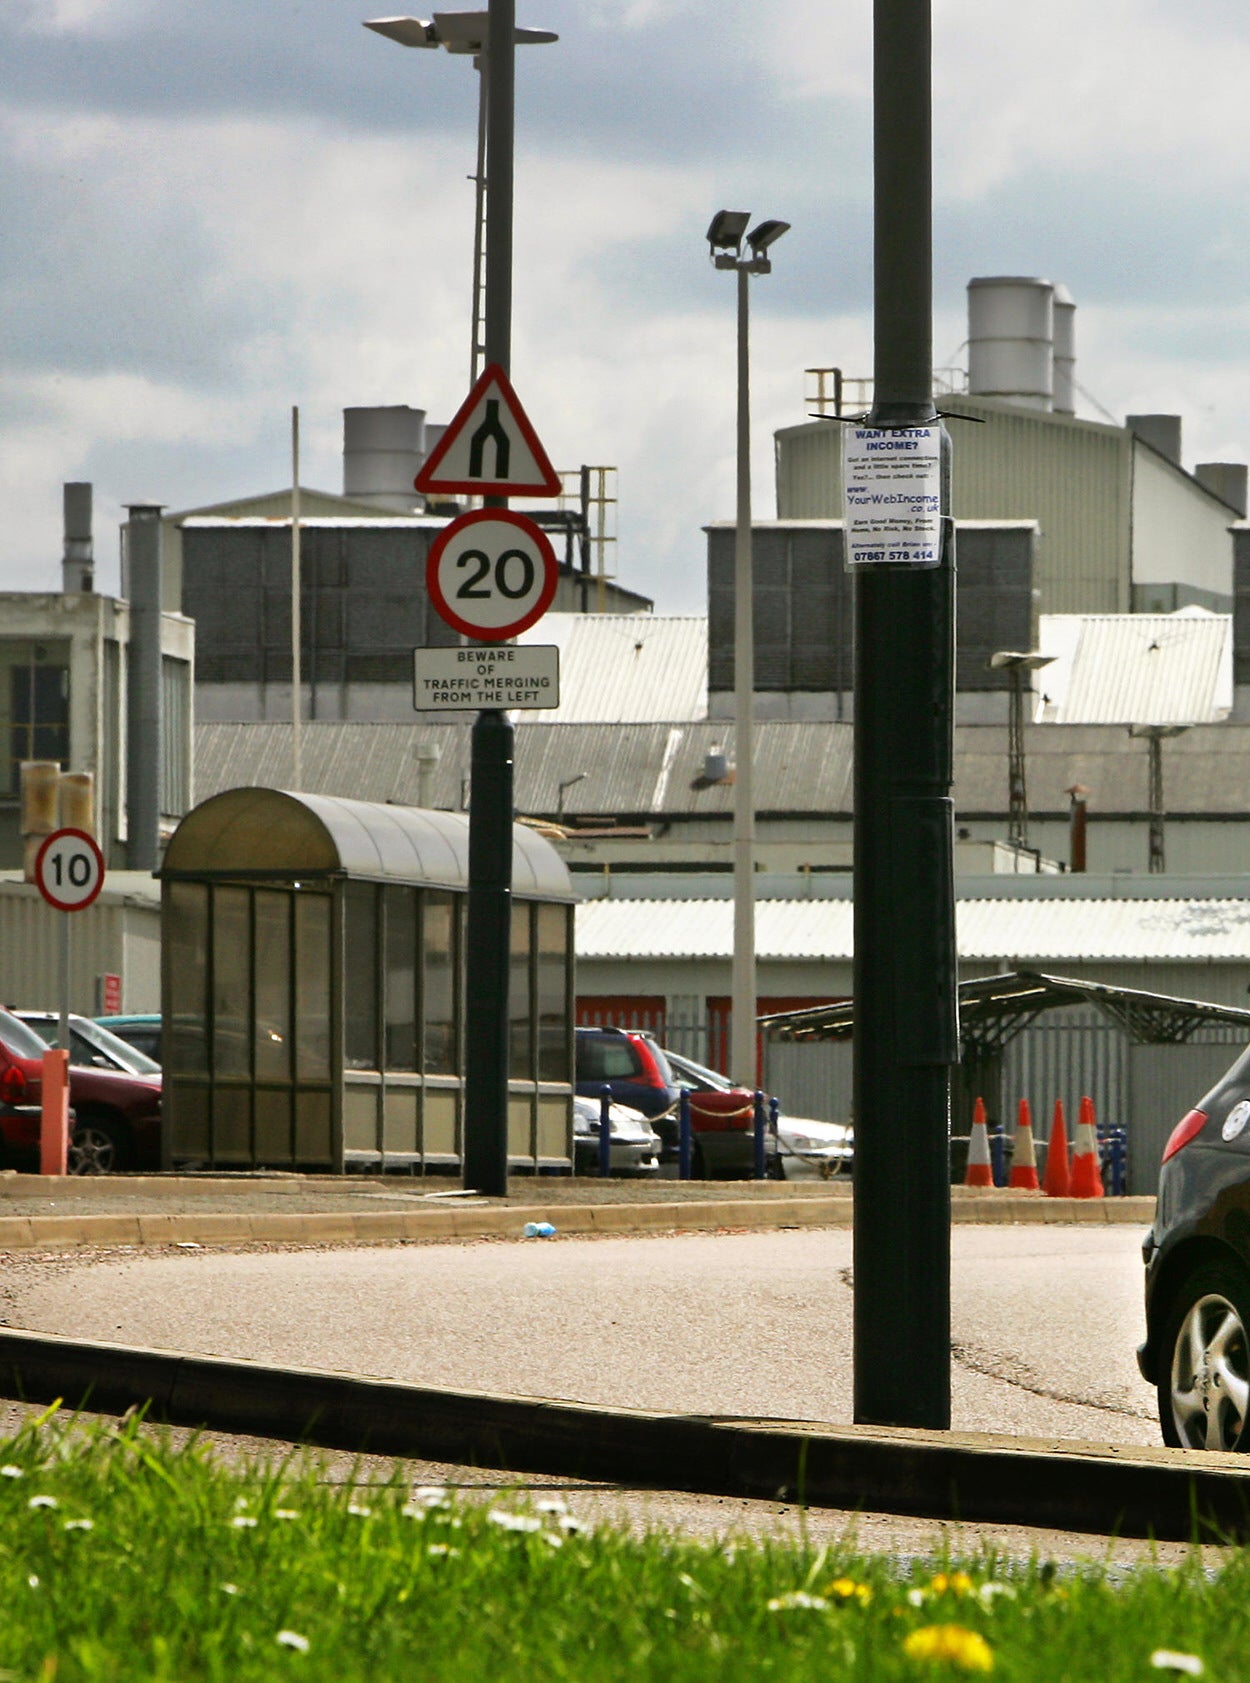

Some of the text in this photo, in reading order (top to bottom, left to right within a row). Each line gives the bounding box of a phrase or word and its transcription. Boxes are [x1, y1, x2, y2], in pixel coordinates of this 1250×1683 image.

[855, 429, 931, 439] WANT EXTRA
[866, 441, 918, 451] INCOME?
[847, 494, 939, 505] YourWebIncome
[854, 551, 933, 561] 07867 578 414
[456, 549, 535, 599] 20
[457, 651, 515, 662] BEWARE
[477, 665, 495, 675] OF
[424, 677, 550, 690] TRAFFIC MERGING
[433, 691, 539, 702] FROM THE LEFT
[52, 854, 91, 887] 10
